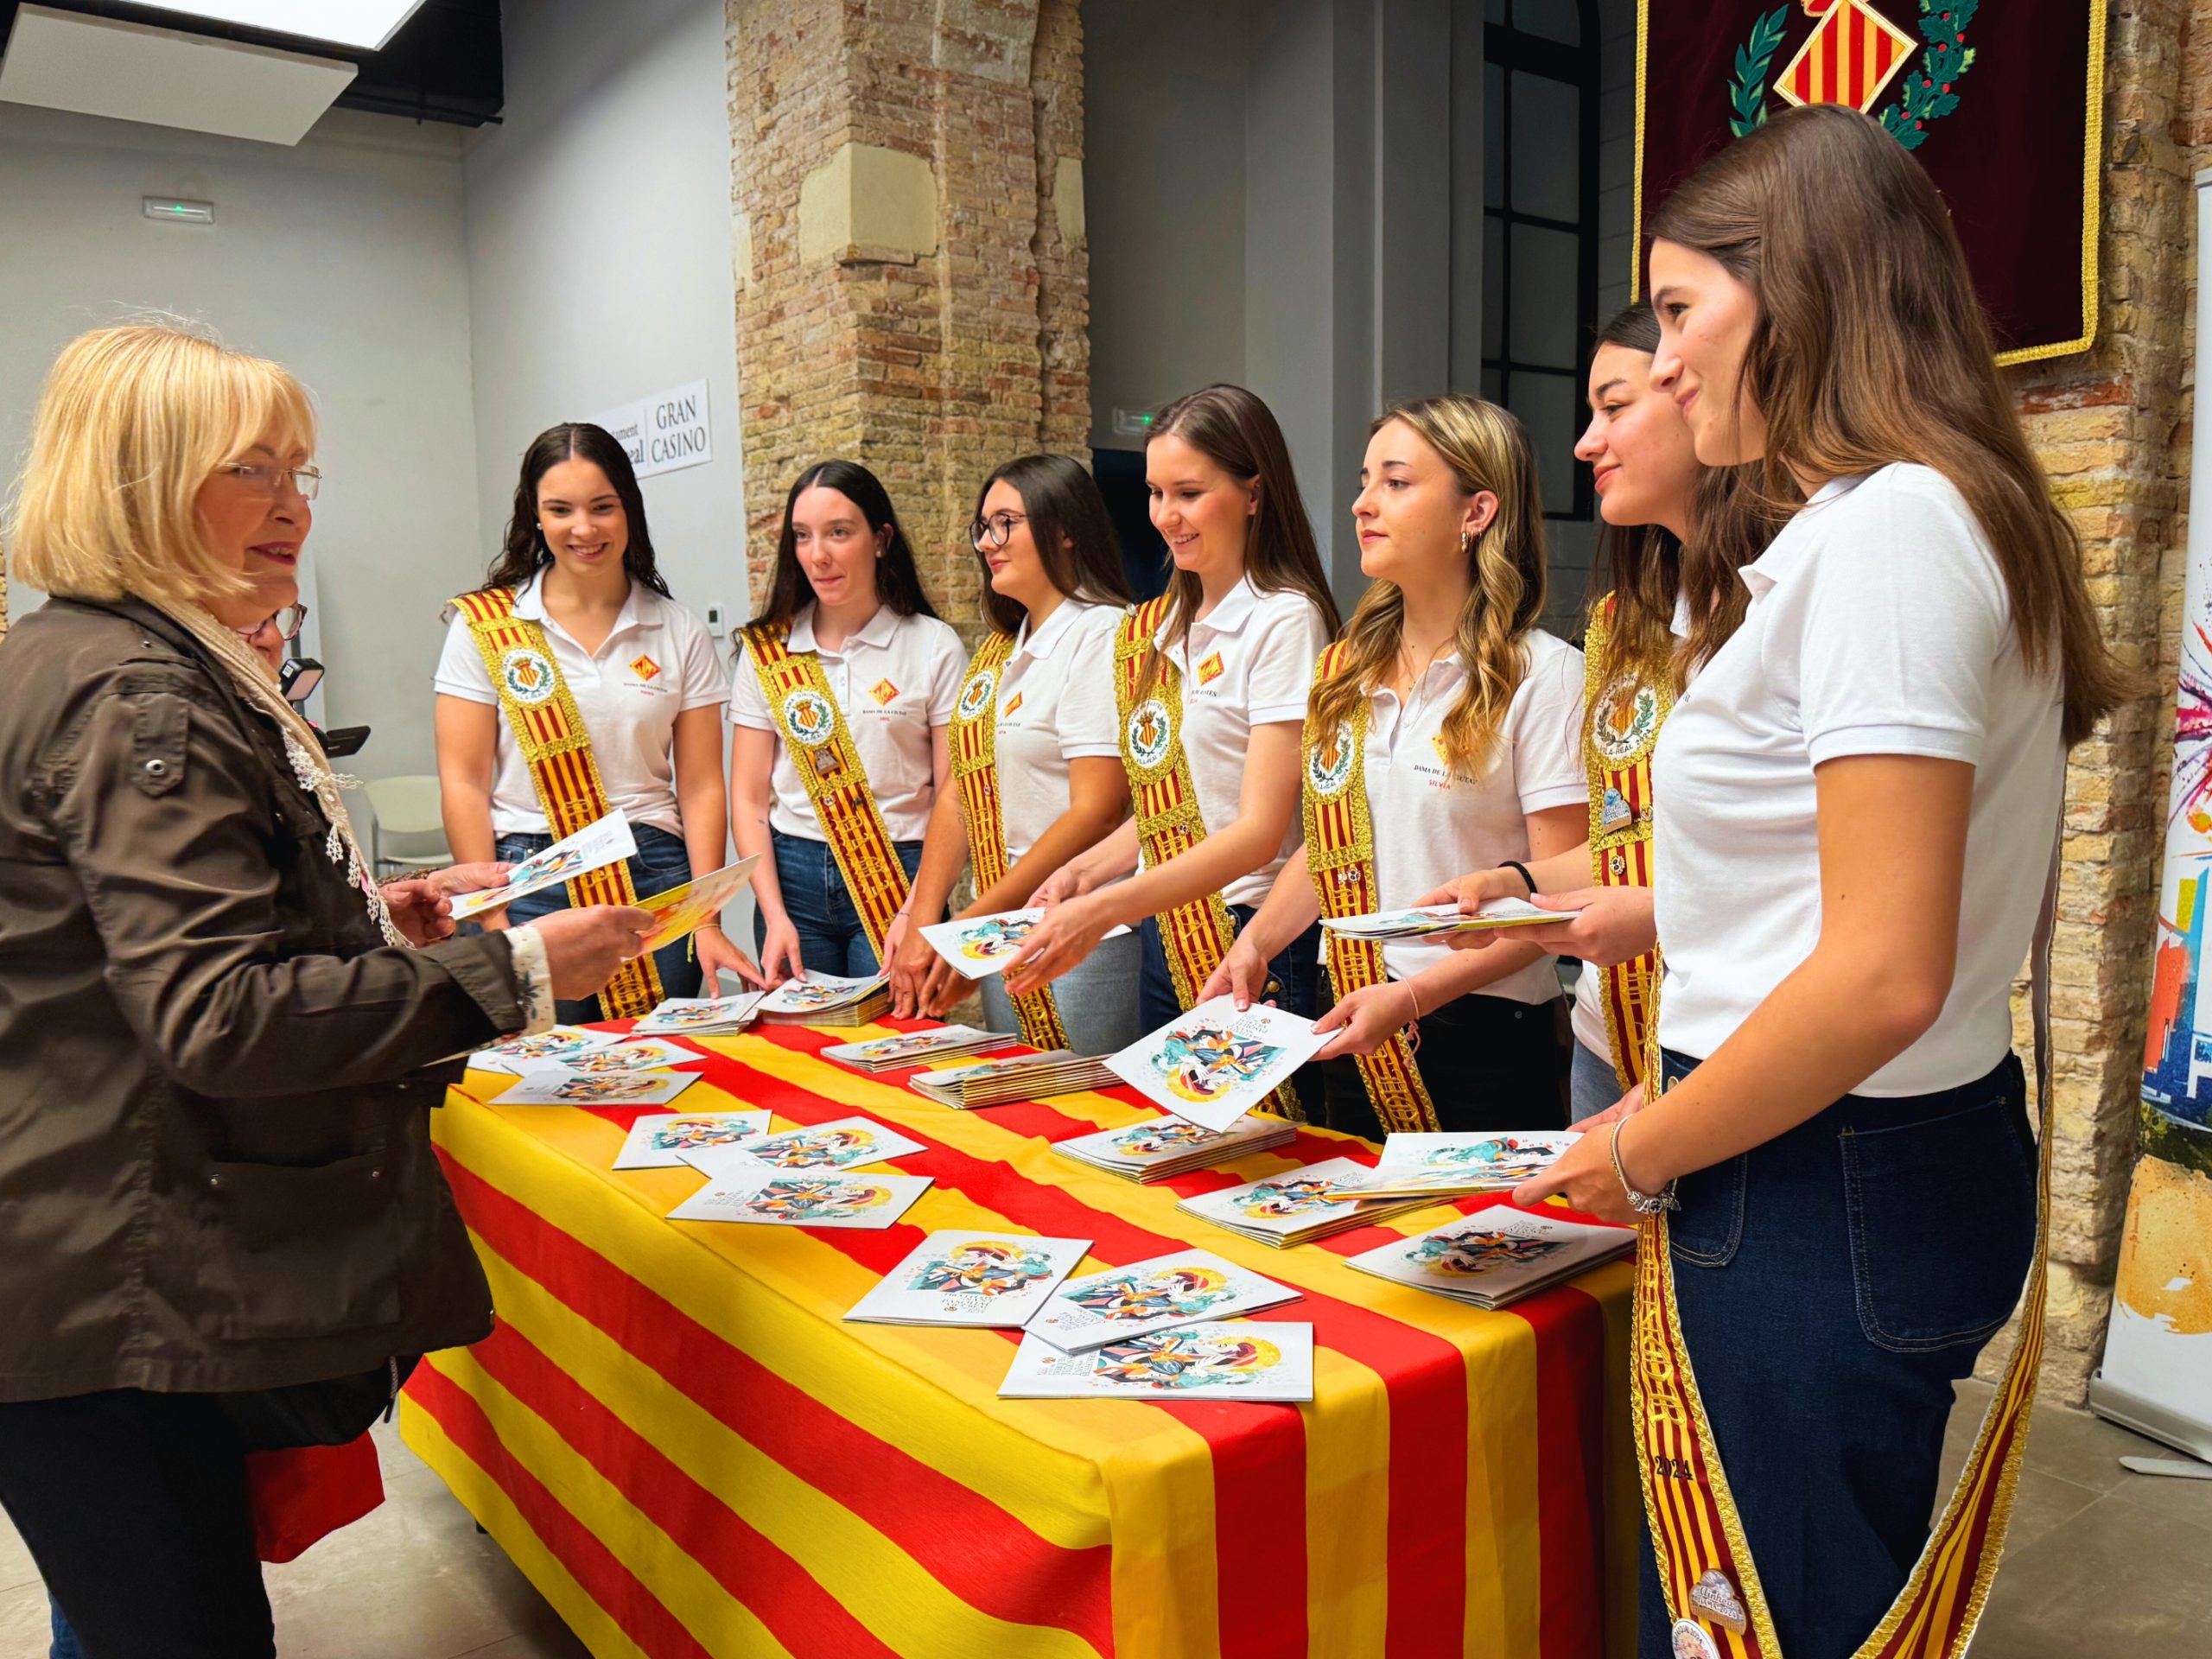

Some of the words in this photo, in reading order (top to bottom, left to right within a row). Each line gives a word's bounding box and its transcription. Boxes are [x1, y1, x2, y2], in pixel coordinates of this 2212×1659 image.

[657, 395, 696, 429] GRAN
[652, 426, 706, 463] CASINO
[1635, 728, 1652, 746] 2024
[1414, 765, 1431, 774] DAMA
[1656, 1454, 1694, 1481] 2024
